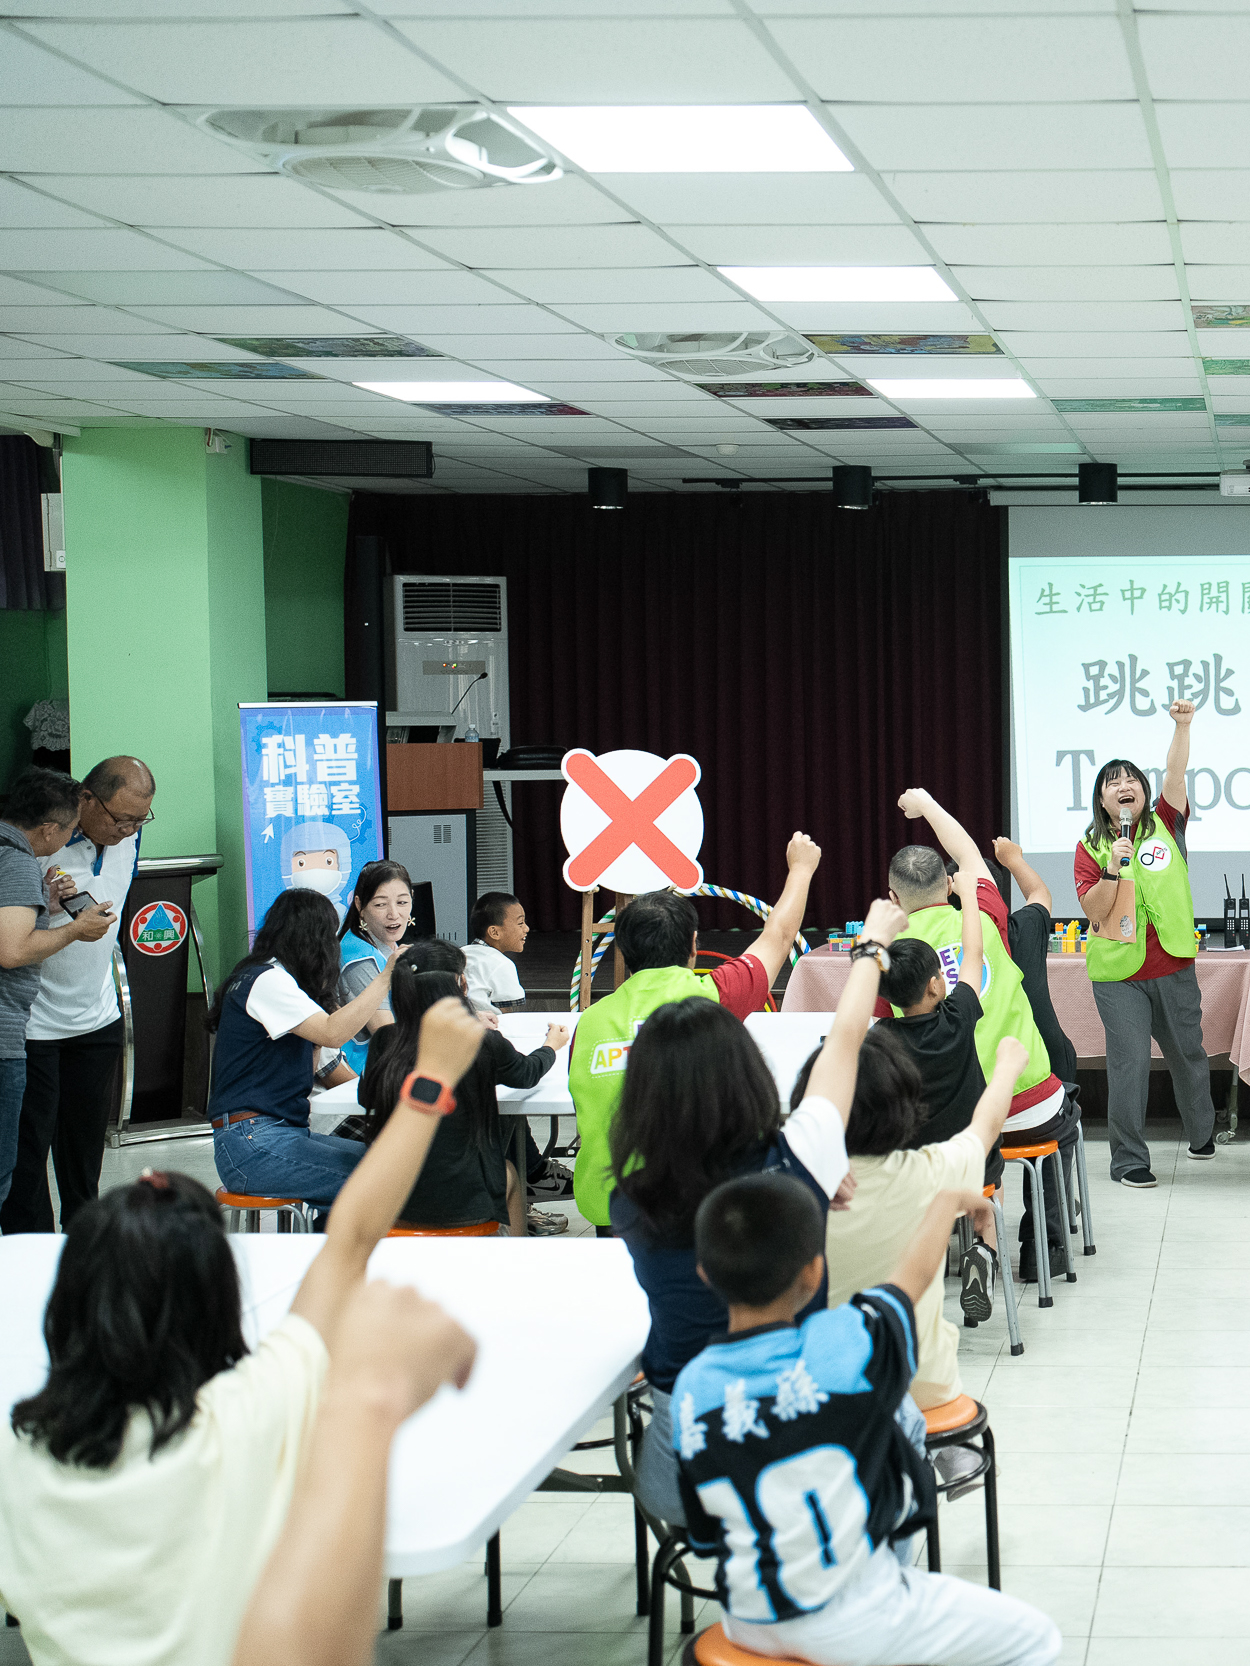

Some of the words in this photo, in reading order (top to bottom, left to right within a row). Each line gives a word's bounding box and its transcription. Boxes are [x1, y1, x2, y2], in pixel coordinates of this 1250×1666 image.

[1077, 653, 1242, 717] 跳跳
[261, 733, 359, 783] 科普
[263, 782, 361, 818] 實驗室
[696, 1443, 872, 1623] 10
